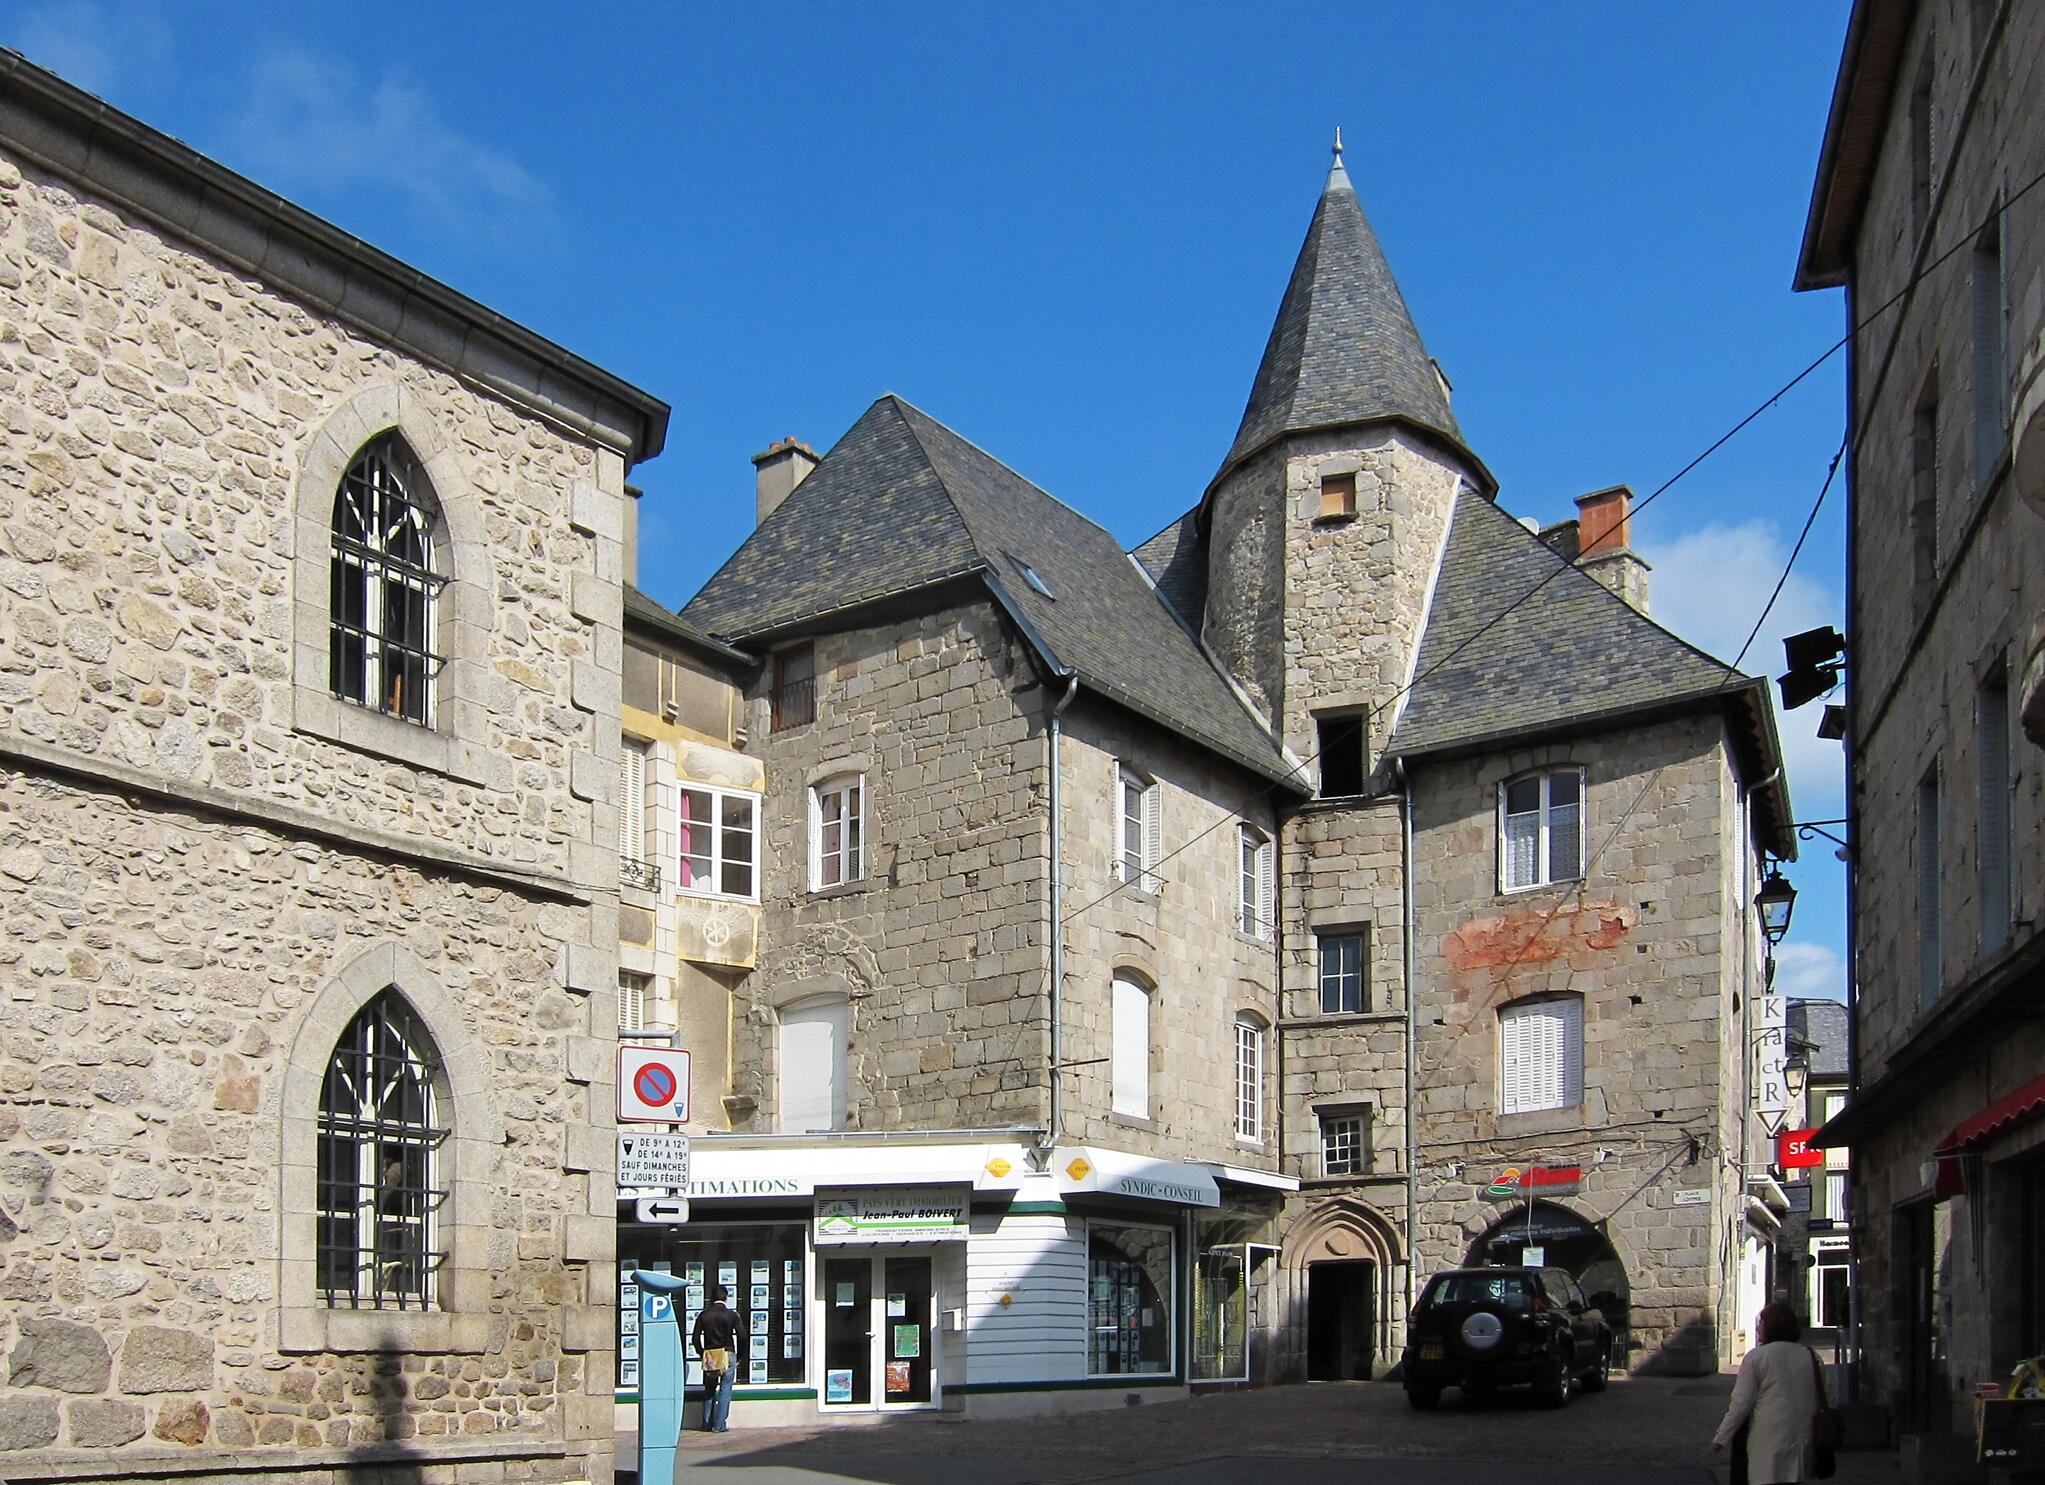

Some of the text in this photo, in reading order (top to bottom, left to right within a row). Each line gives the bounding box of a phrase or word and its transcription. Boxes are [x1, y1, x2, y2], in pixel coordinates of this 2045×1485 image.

[640, 1138, 650, 1147] DE
[1789, 1141, 1822, 1154] SF
[637, 1150, 648, 1158] DE
[621, 1161, 687, 1172] SAUF DIMANCHES
[621, 1172, 687, 1183] ET JOURS FÉRIÉS
[664, 1179, 798, 1196] TIMATIONS
[1120, 1179, 1158, 1196] SYNDIC
[1163, 1184, 1203, 1202] CONSEIL
[863, 1195, 963, 1208] PAYS VERT IMMOBILIER
[863, 1208, 963, 1219] Jean-Paul BOIVERT
[652, 1296, 668, 1319] P
